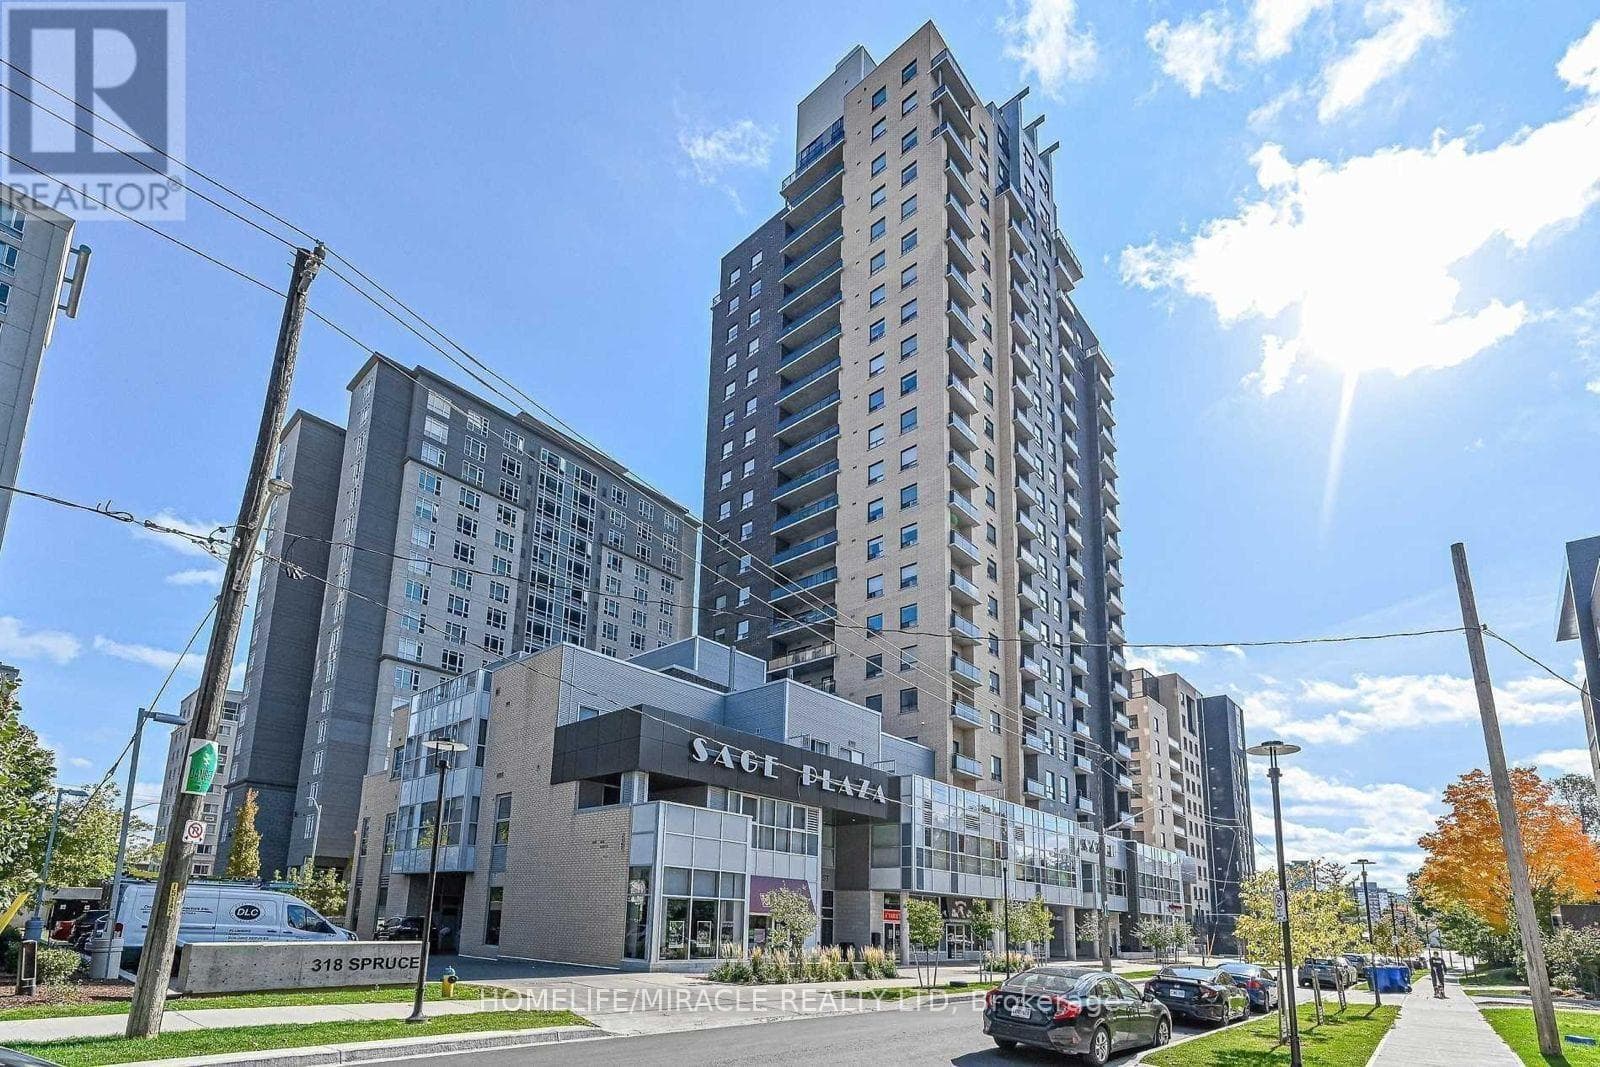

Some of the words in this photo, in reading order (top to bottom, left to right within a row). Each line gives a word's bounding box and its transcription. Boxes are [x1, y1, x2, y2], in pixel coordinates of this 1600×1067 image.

[692, 736, 779, 779] SAGE
[802, 764, 886, 804] PLAZA
[237, 908, 259, 916] DLC
[311, 958, 343, 972] 318
[348, 957, 420, 971] SPRUCE
